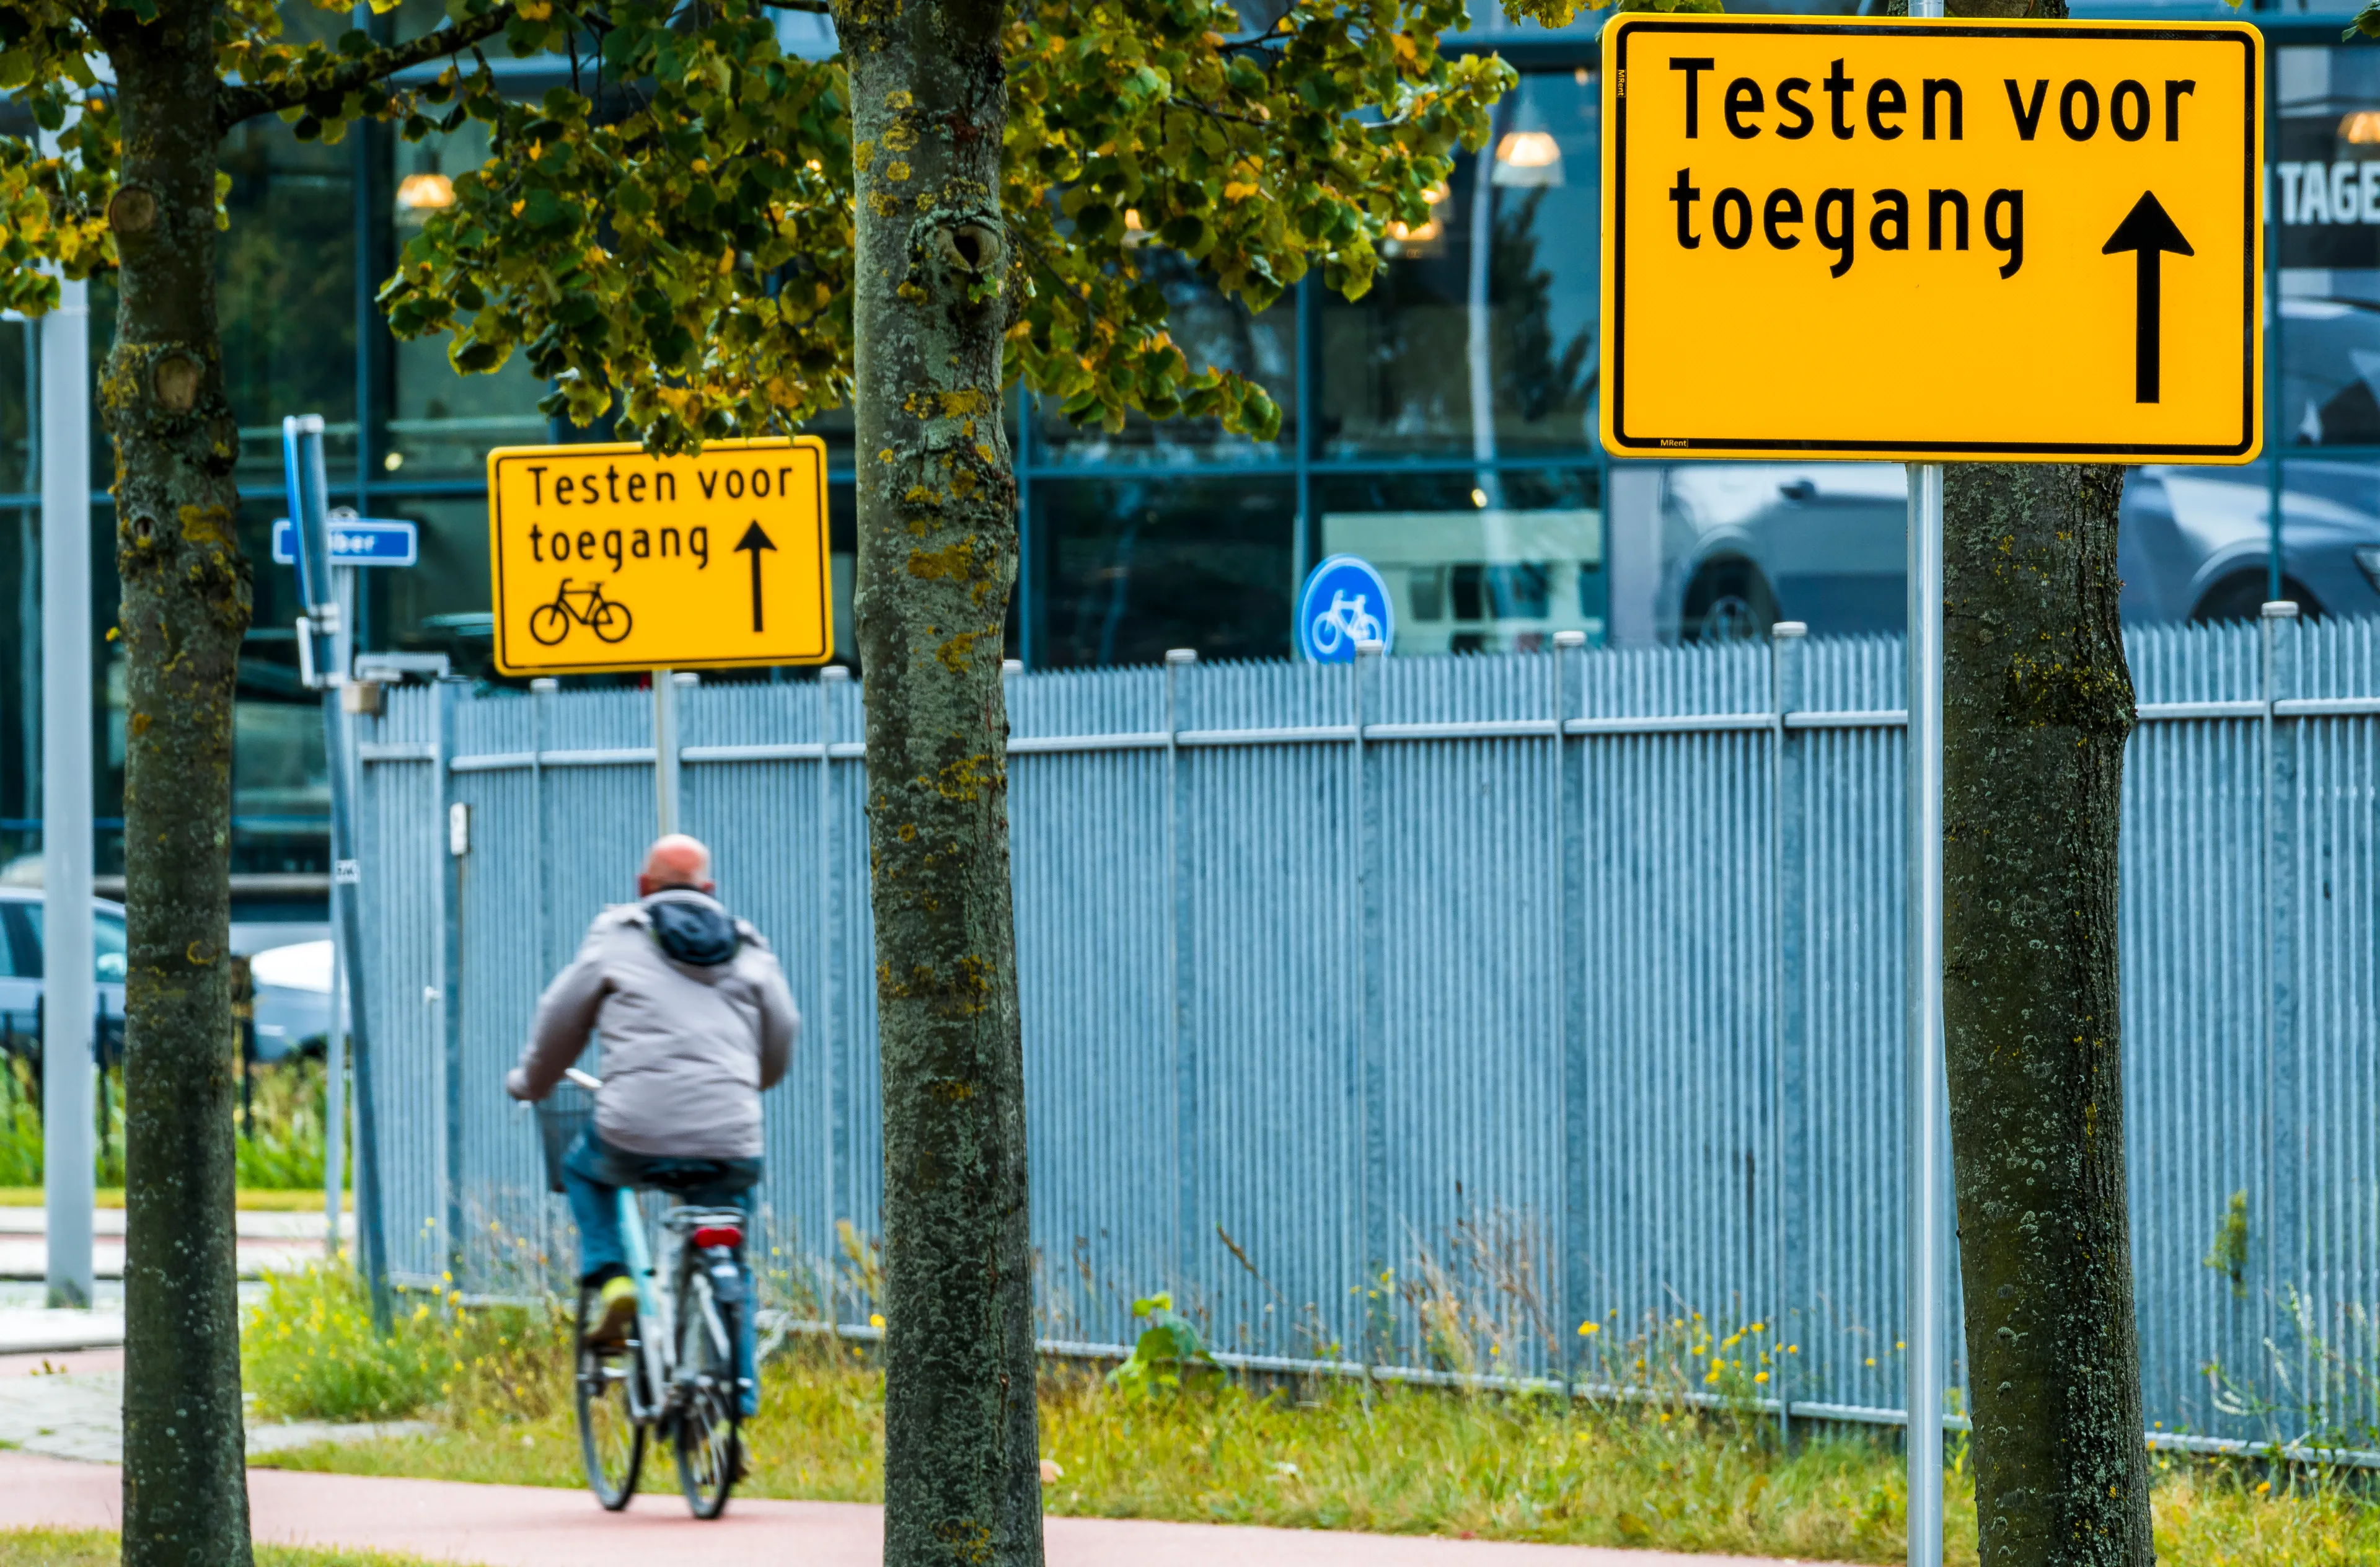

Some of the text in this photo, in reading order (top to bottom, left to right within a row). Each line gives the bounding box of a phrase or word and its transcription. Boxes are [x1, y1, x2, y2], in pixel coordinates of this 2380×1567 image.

[1669, 57, 2196, 142] Testen voor
[2263, 161, 2380, 224] TAGE
[1669, 167, 2024, 280] toegang
[1660, 439, 1686, 447] MRent
[527, 465, 792, 506] Testen voor
[529, 523, 708, 573] toegang
